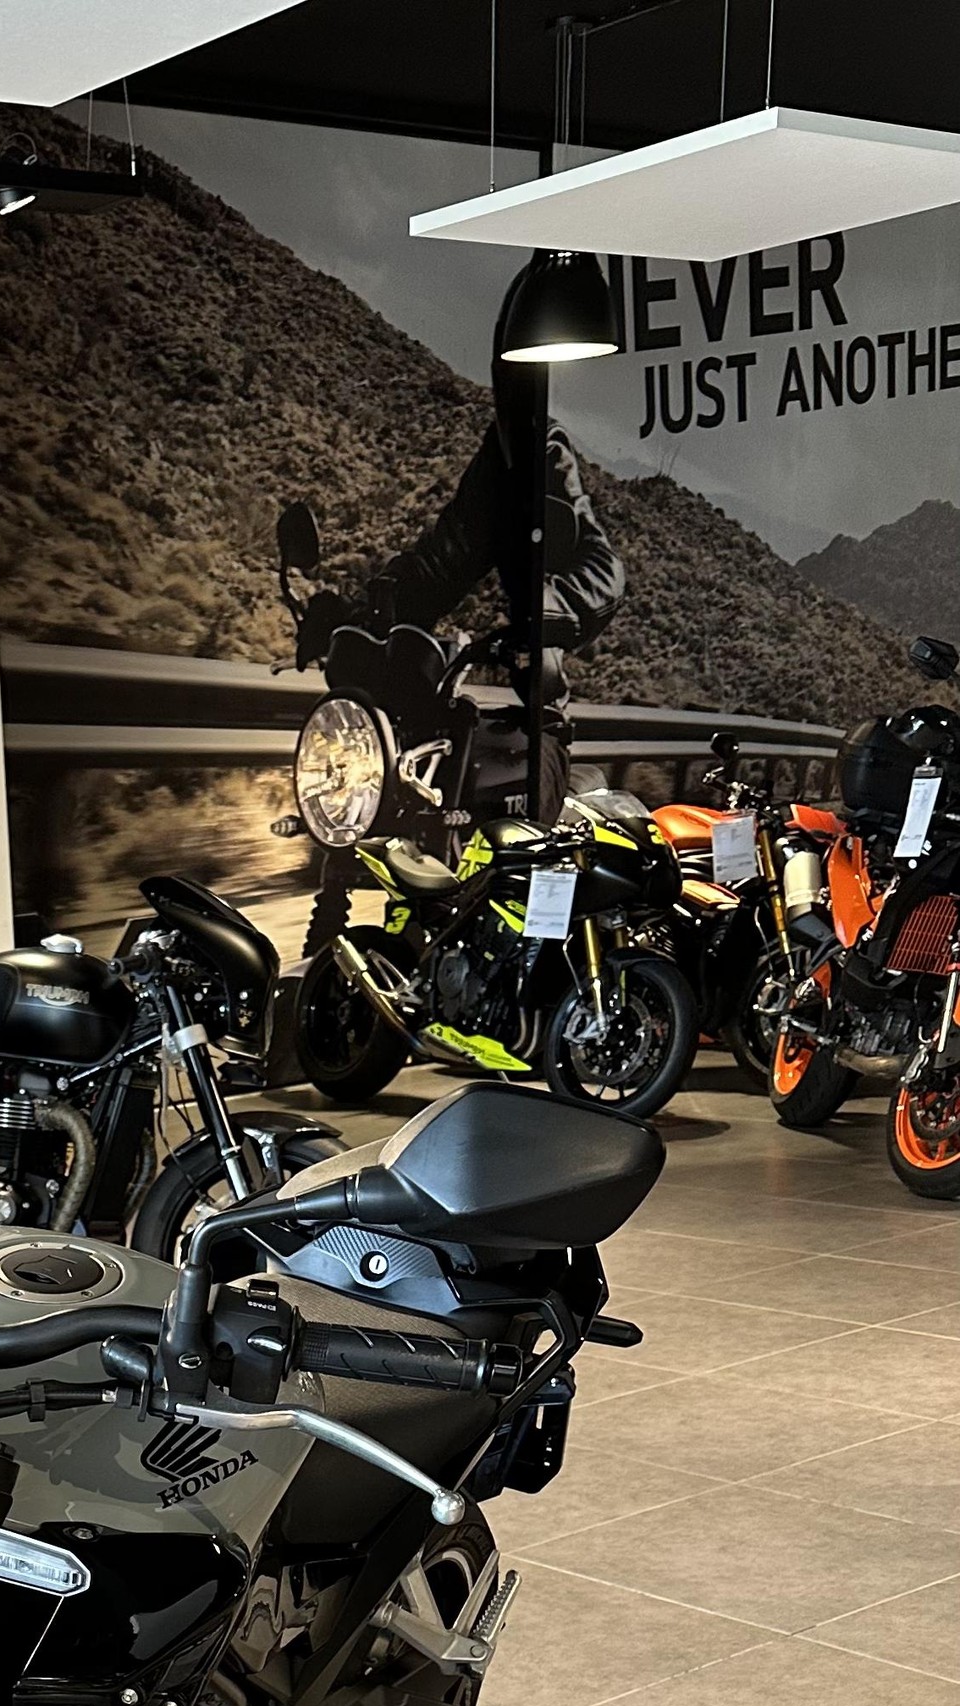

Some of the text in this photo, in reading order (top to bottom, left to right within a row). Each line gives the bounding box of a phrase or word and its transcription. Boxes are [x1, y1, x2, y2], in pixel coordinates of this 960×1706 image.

[639, 352, 757, 439] JUST
[385, 907, 411, 934] 3
[25, 983, 90, 1006] TRIUMPH
[156, 1449, 259, 1509] HONDA
